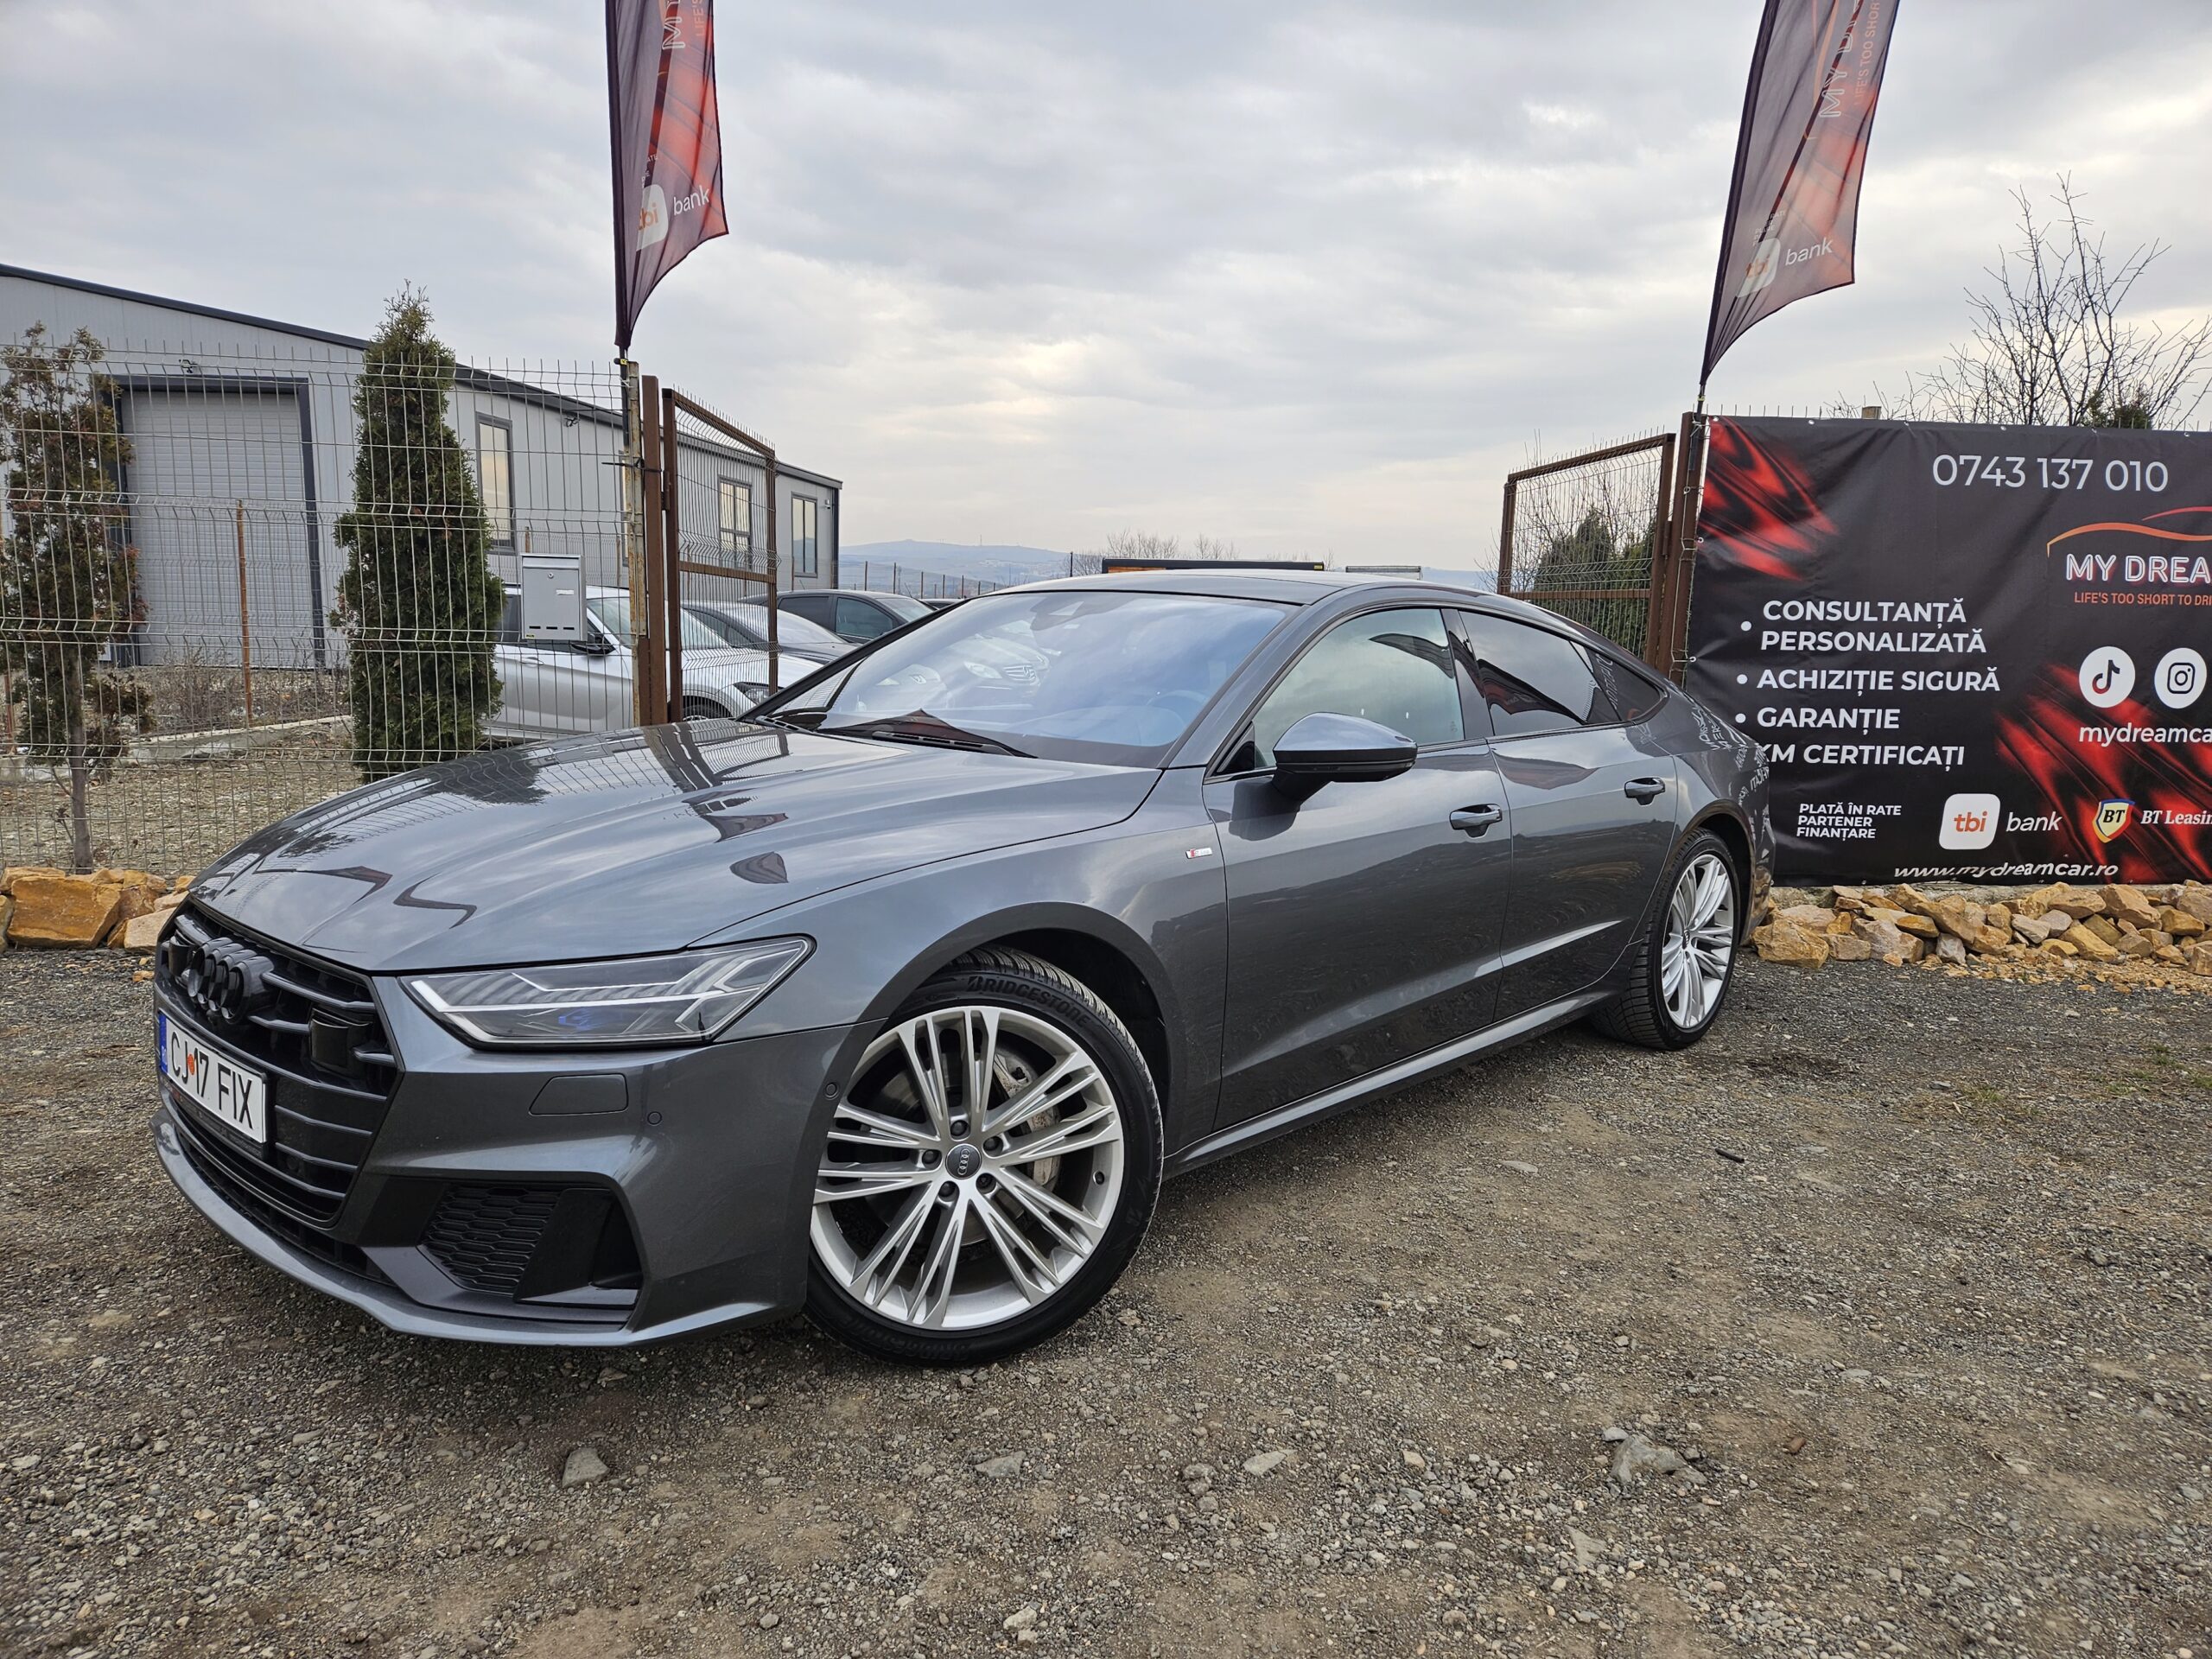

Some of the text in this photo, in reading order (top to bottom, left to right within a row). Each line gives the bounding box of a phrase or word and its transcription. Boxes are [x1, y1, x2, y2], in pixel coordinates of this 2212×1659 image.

[1859, 41, 1873, 67] TOO
[674, 185, 709, 215] bank
[1785, 237, 1833, 266] bank
[1932, 454, 2169, 493] 0743 137 010
[2066, 553, 2212, 584] MY DREA
[2074, 592, 2108, 604] LIFE'S
[2111, 593, 2135, 604] TOO
[2137, 594, 2176, 605] SHORT
[2177, 594, 2192, 605] TO
[1763, 597, 1967, 629] CONSULTANȚĂ
[1761, 628, 1986, 653] PERSONALIZATĂ
[1757, 666, 2001, 696] ACHIZIȚIE SIGURĂ
[1757, 707, 1900, 735] GARANȚIE
[2078, 721, 2212, 747] mydreamca
[1803, 744, 1965, 772] CERTIFICAȚI
[1797, 815, 1873, 827] PARTENER
[1799, 802, 1902, 816] PLATĂ ÎN RATE
[1954, 810, 2063, 832] tbi bank
[2103, 809, 2126, 823] BT
[2140, 810, 2163, 824] BT
[1796, 827, 1877, 842] FINANȚARE
[1893, 861, 2119, 879] www.mydreamcar.ro
[217, 1063, 253, 1130] FIX
